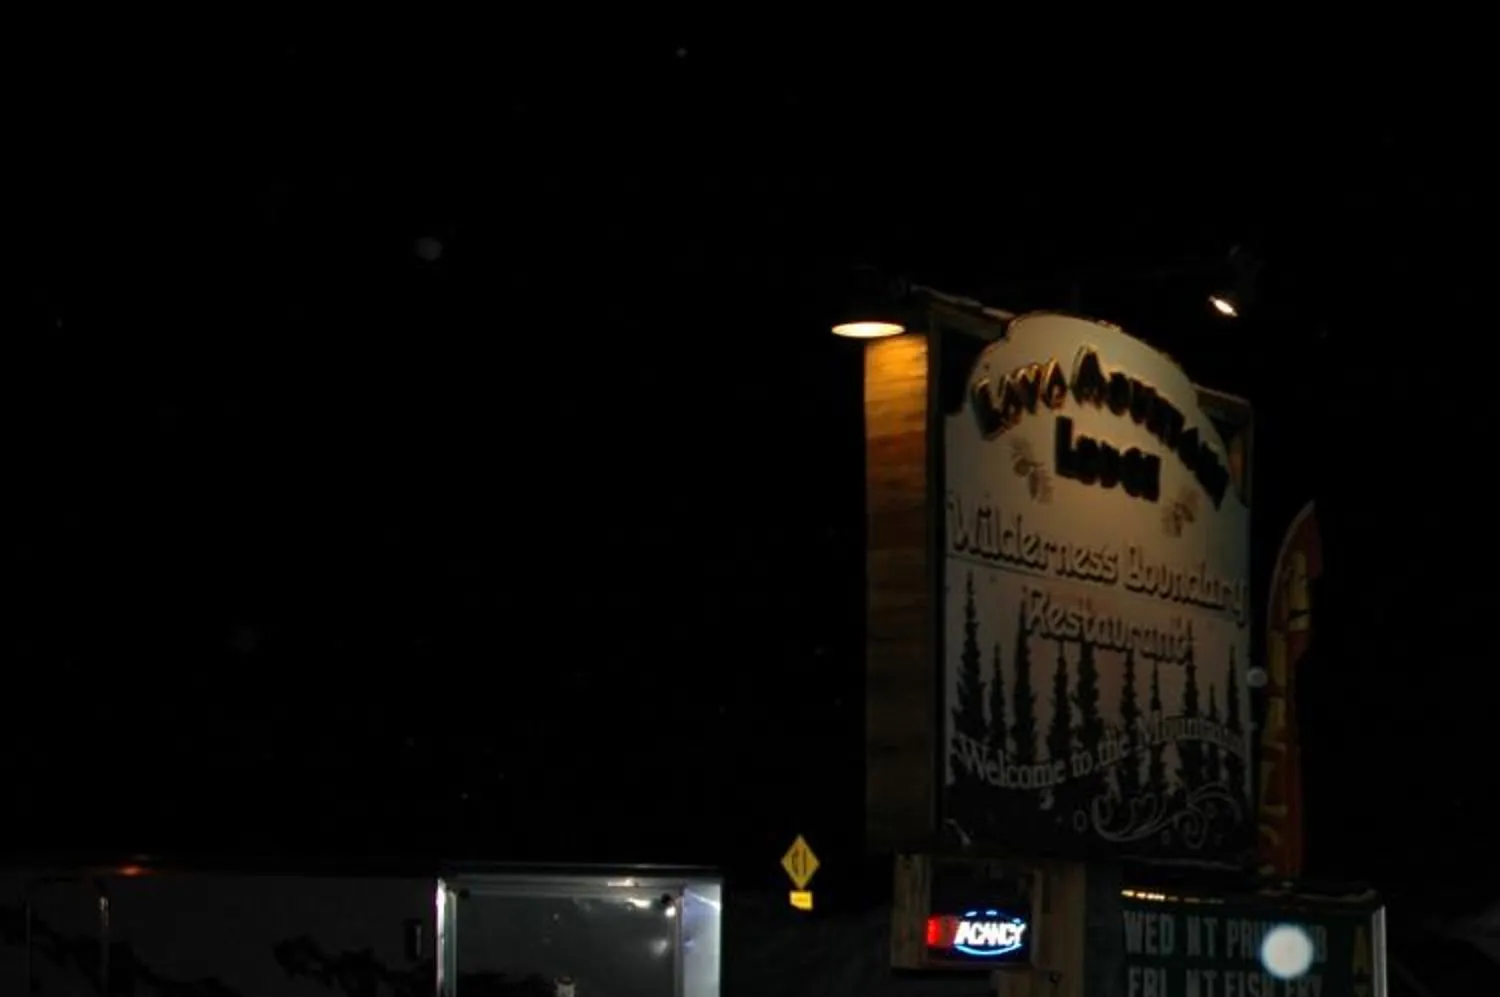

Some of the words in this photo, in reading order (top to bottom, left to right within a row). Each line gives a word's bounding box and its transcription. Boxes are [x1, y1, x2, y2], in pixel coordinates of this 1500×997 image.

[947, 495, 1119, 585] Wilderness
[1025, 585, 1195, 666] Restaurant
[951, 730, 1068, 790] Welcome
[1071, 748, 1094, 779] to
[1122, 909, 1176, 956] WED
